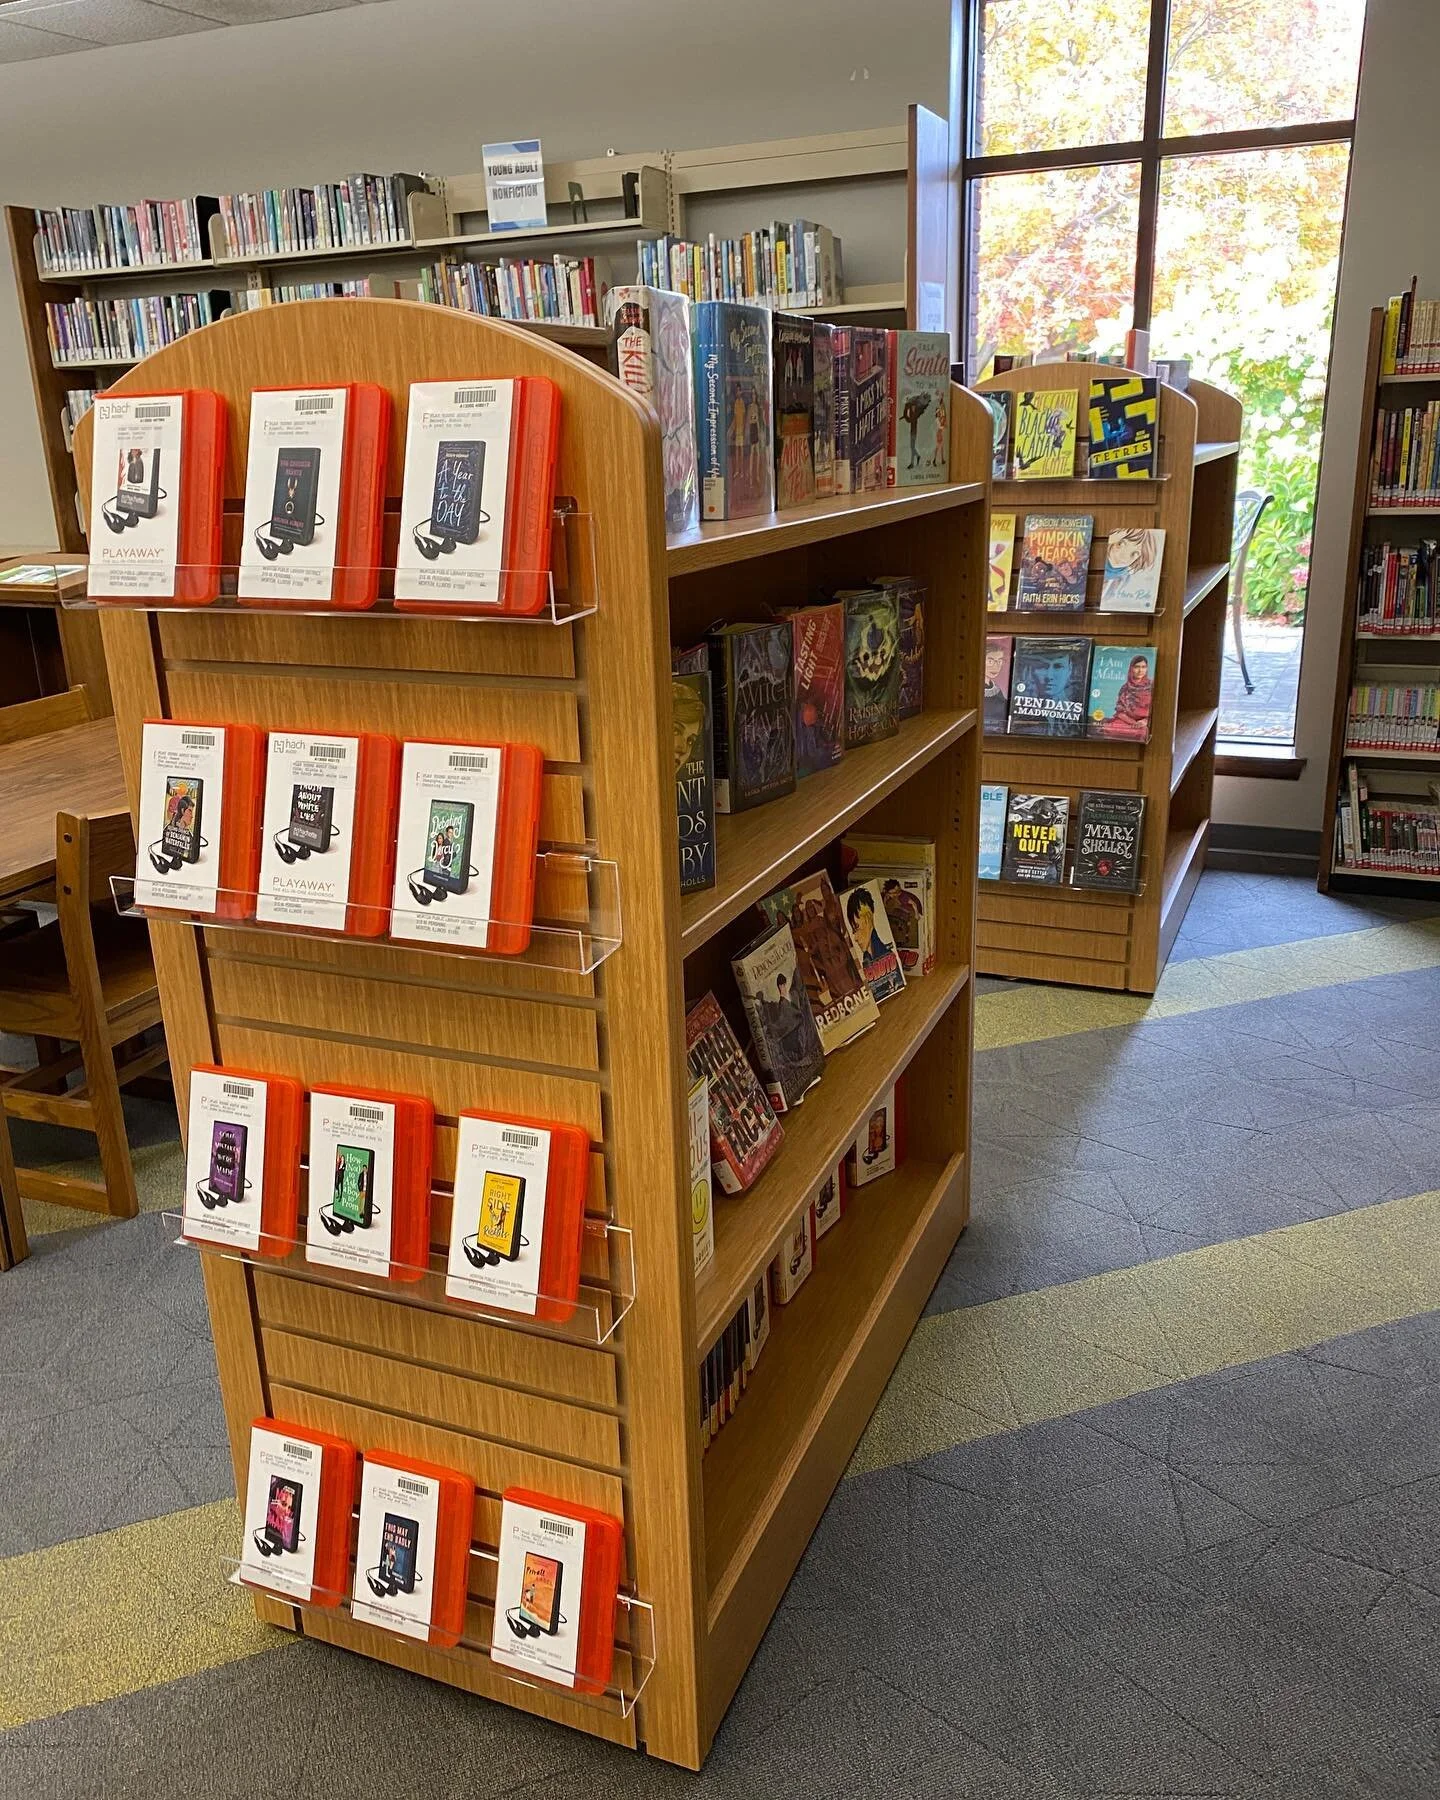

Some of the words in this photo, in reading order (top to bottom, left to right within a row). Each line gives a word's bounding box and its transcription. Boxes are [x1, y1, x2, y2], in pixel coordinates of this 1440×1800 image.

[487, 164, 513, 177] YOUNG
[514, 161, 539, 174] ADULT
[491, 183, 539, 201] NONFICTION
[622, 336, 643, 347] THE
[704, 354, 720, 369] My
[904, 346, 949, 378] Santa
[706, 369, 720, 405] Second
[858, 407, 877, 441] HATE
[1018, 406, 1052, 437] BLACK
[707, 404, 720, 457] Impression
[1092, 442, 1150, 465] TETRIS
[437, 459, 450, 484] A
[452, 460, 474, 491] Year
[1060, 517, 1089, 529] ROWELL
[1029, 530, 1086, 548] PUMPKIN
[102, 548, 161, 558] PLAYAWAY
[1035, 547, 1077, 564] HEADS
[1022, 592, 1041, 604] FAITH
[1041, 593, 1059, 605] ERIN
[1059, 593, 1080, 605] HICKS
[793, 618, 818, 674] TASTING
[800, 650, 819, 691] LIGHT
[1105, 658, 1124, 668] Am
[1092, 668, 1126, 681] Malala
[1013, 695, 1044, 709] TEN
[1045, 698, 1084, 713] DAYS
[849, 702, 888, 724] RAISING
[1017, 706, 1082, 721] MADWOMAN
[685, 759, 705, 777] THE
[297, 791, 322, 801] ABOUT
[297, 801, 320, 813] WHITE
[430, 812, 463, 839] Debating
[1013, 823, 1057, 841] NEVER
[1084, 823, 1135, 842] MARY
[1018, 838, 1050, 854] QUIT
[1081, 838, 1133, 860] SHELLEY
[272, 876, 332, 892] PLAYAWAY
[815, 985, 872, 1032] REDBONE
[346, 1152, 363, 1164] How
[489, 1188, 512, 1201] RIGHT
[341, 1197, 359, 1212] Prom
[487, 1197, 511, 1213] SIDE
[526, 1566, 546, 1577] Private
